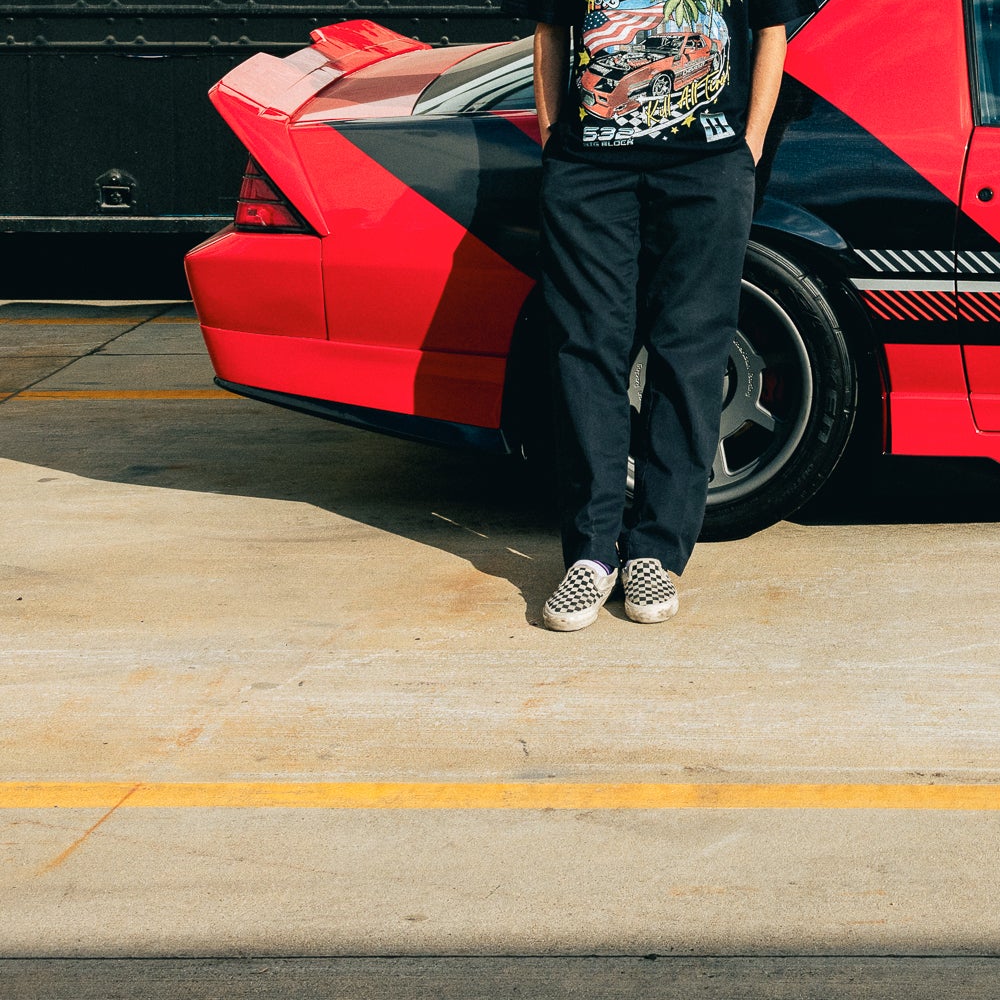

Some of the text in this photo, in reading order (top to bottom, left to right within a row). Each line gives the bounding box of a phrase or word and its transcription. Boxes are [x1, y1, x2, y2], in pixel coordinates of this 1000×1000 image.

[645, 93, 672, 127] Kill
[677, 82, 699, 111] All
[601, 138, 635, 148] BLOCK
